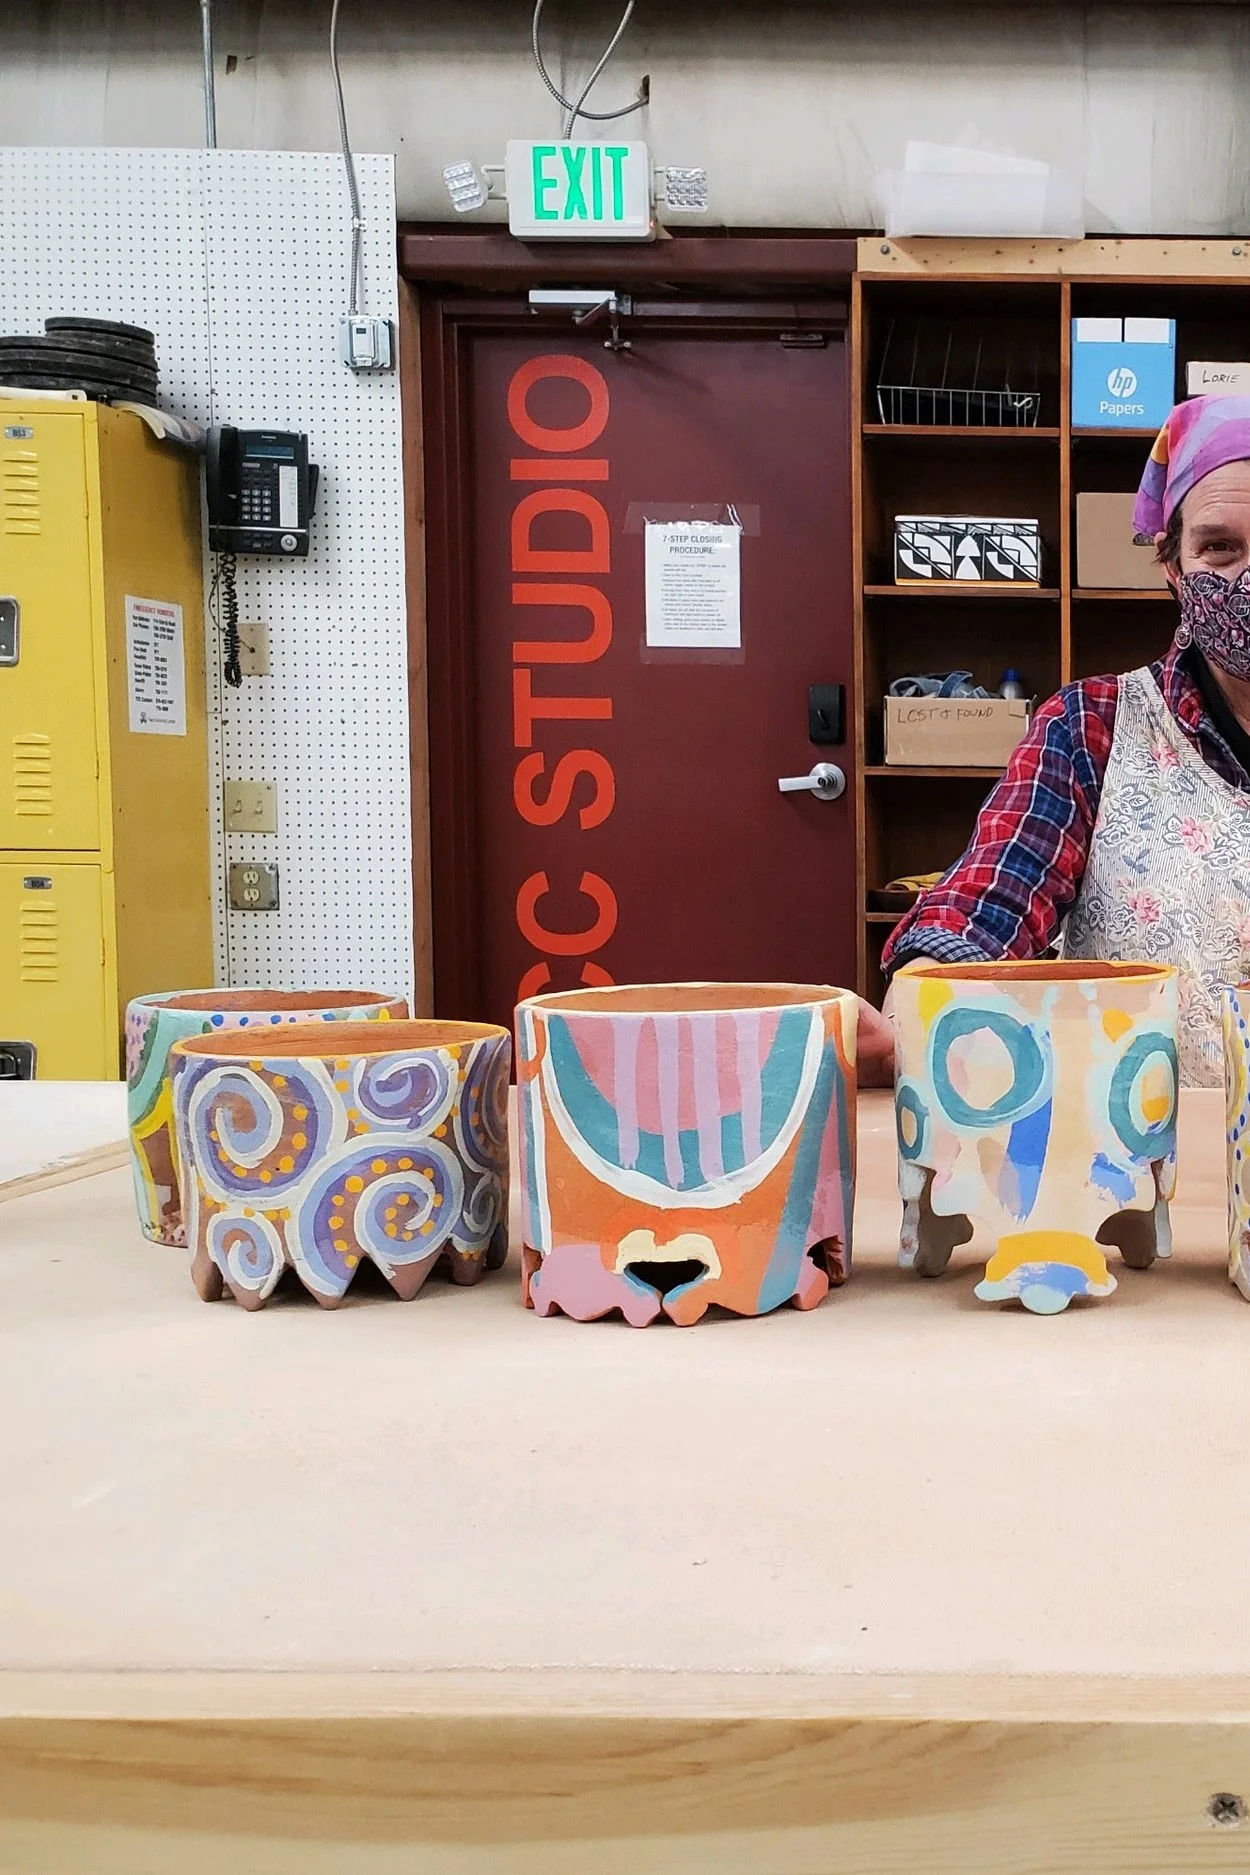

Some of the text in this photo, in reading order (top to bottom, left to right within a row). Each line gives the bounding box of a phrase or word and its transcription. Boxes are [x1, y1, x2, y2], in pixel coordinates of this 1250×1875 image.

[532, 146, 629, 220] EXIT
[1109, 368, 1136, 398] hp
[1202, 370, 1241, 384] LORIE
[1100, 402, 1145, 416] Papers
[663, 535, 723, 544] 7-STEP CLOSING
[507, 355, 616, 830] STUDIO
[957, 706, 994, 721] FOUND
